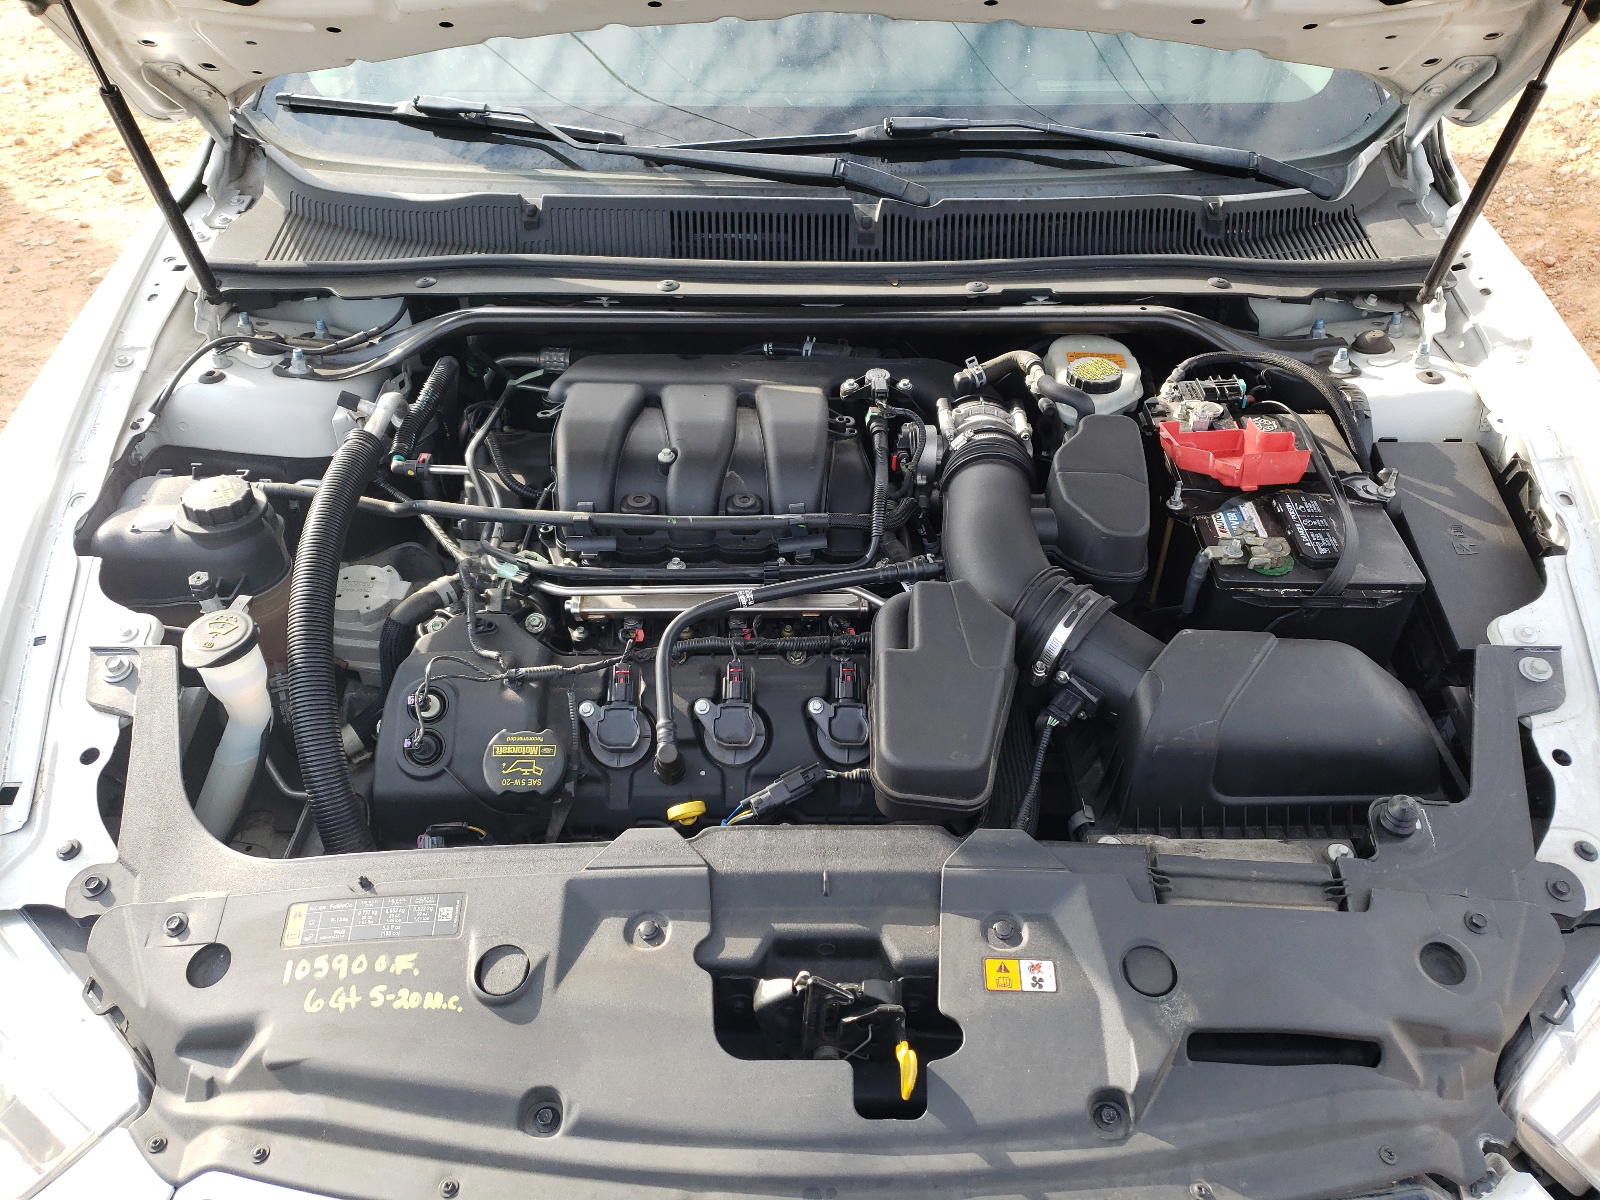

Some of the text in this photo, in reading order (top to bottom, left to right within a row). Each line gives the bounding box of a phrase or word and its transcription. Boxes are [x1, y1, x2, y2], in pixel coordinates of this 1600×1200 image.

[494, 746, 539, 755] Motorcraft
[527, 778, 542, 786] SAE
[303, 988, 325, 1013] 6
